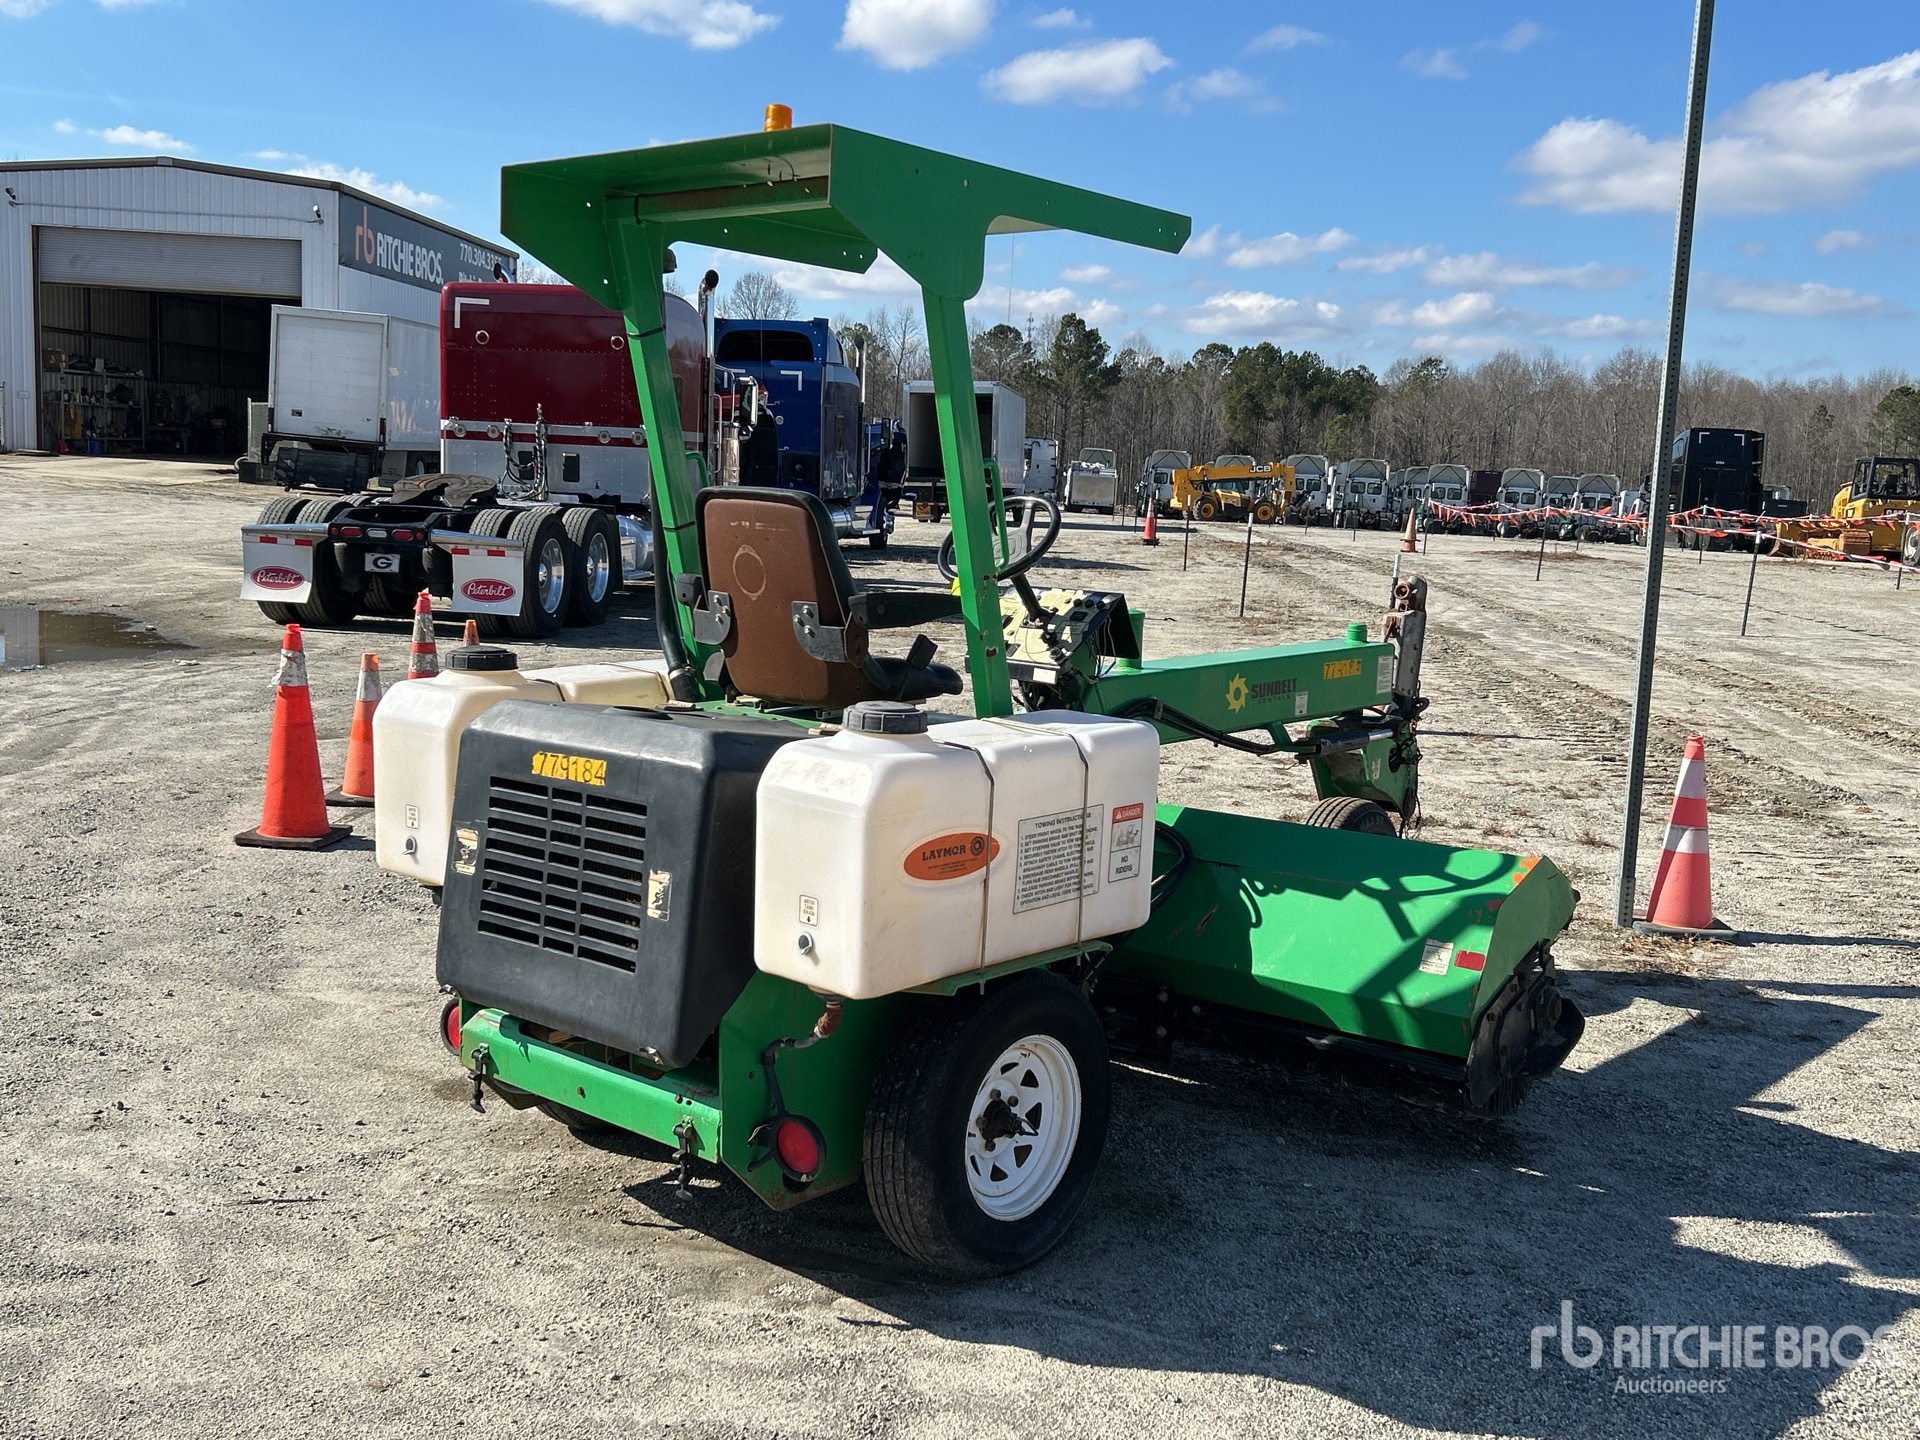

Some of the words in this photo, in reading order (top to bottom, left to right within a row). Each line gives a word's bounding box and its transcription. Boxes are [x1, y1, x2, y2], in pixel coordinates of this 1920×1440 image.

[355, 206, 375, 264] rb
[376, 232, 414, 276] RITCHIE
[415, 245, 443, 285] BROS.
[460, 242, 501, 271] 770.304.33
[257, 569, 300, 584] Peterbilt
[467, 582, 511, 596] Peterbilt
[1251, 677, 1297, 700] SUNBELT
[1257, 694, 1291, 704] RENTALS
[539, 752, 606, 785] 779184
[1122, 807, 1141, 818] DANGER
[1034, 819, 1055, 829] TOWING
[921, 844, 967, 861] LAYMOR
[1121, 855, 1129, 864] NO
[1115, 864, 1133, 875] RIDERS
